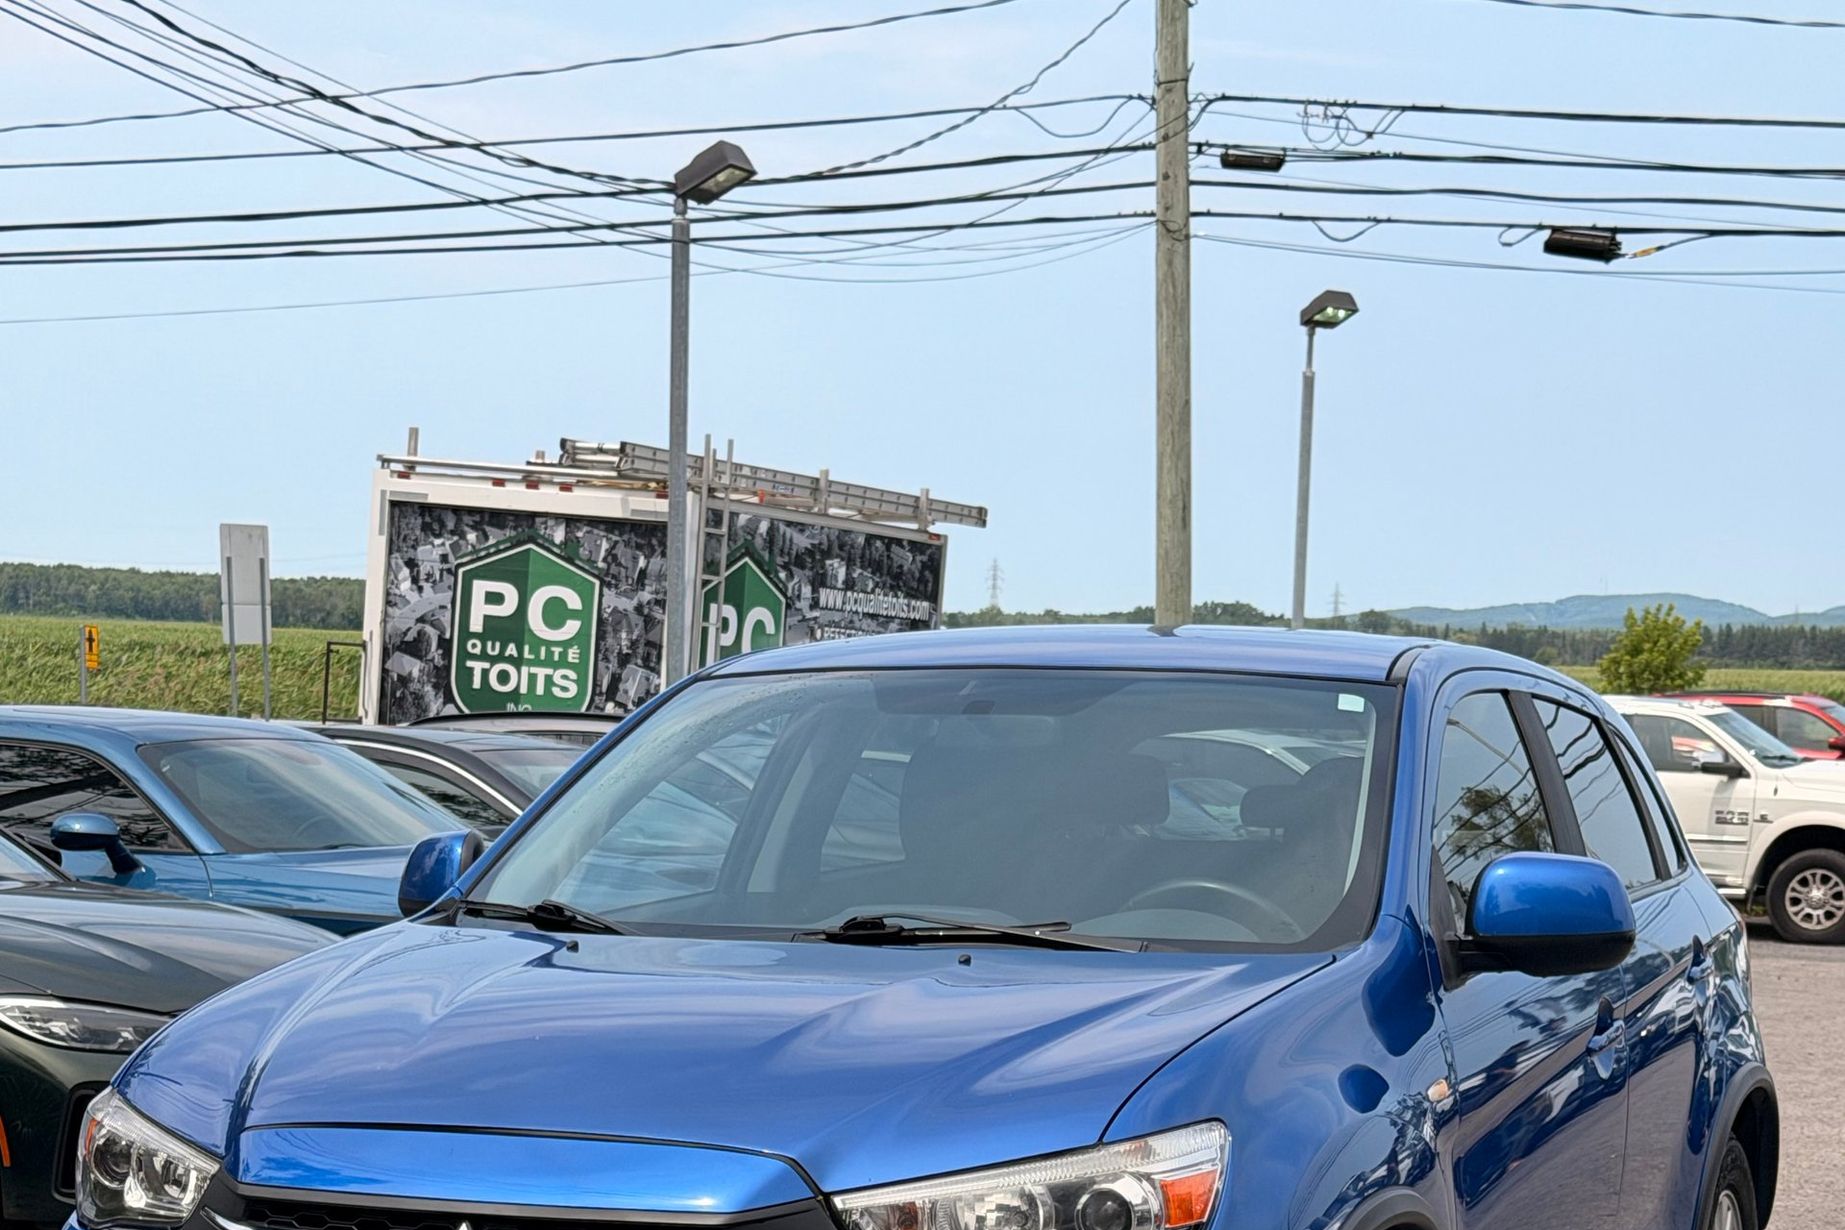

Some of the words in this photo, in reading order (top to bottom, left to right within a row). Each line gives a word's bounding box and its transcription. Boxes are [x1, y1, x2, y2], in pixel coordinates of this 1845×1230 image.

[469, 579, 583, 641] PC
[819, 587, 930, 620] www.pcqualitetoits.com
[466, 638, 581, 663] QUALITÉ
[706, 603, 776, 667] PC
[465, 660, 578, 699] TOITS
